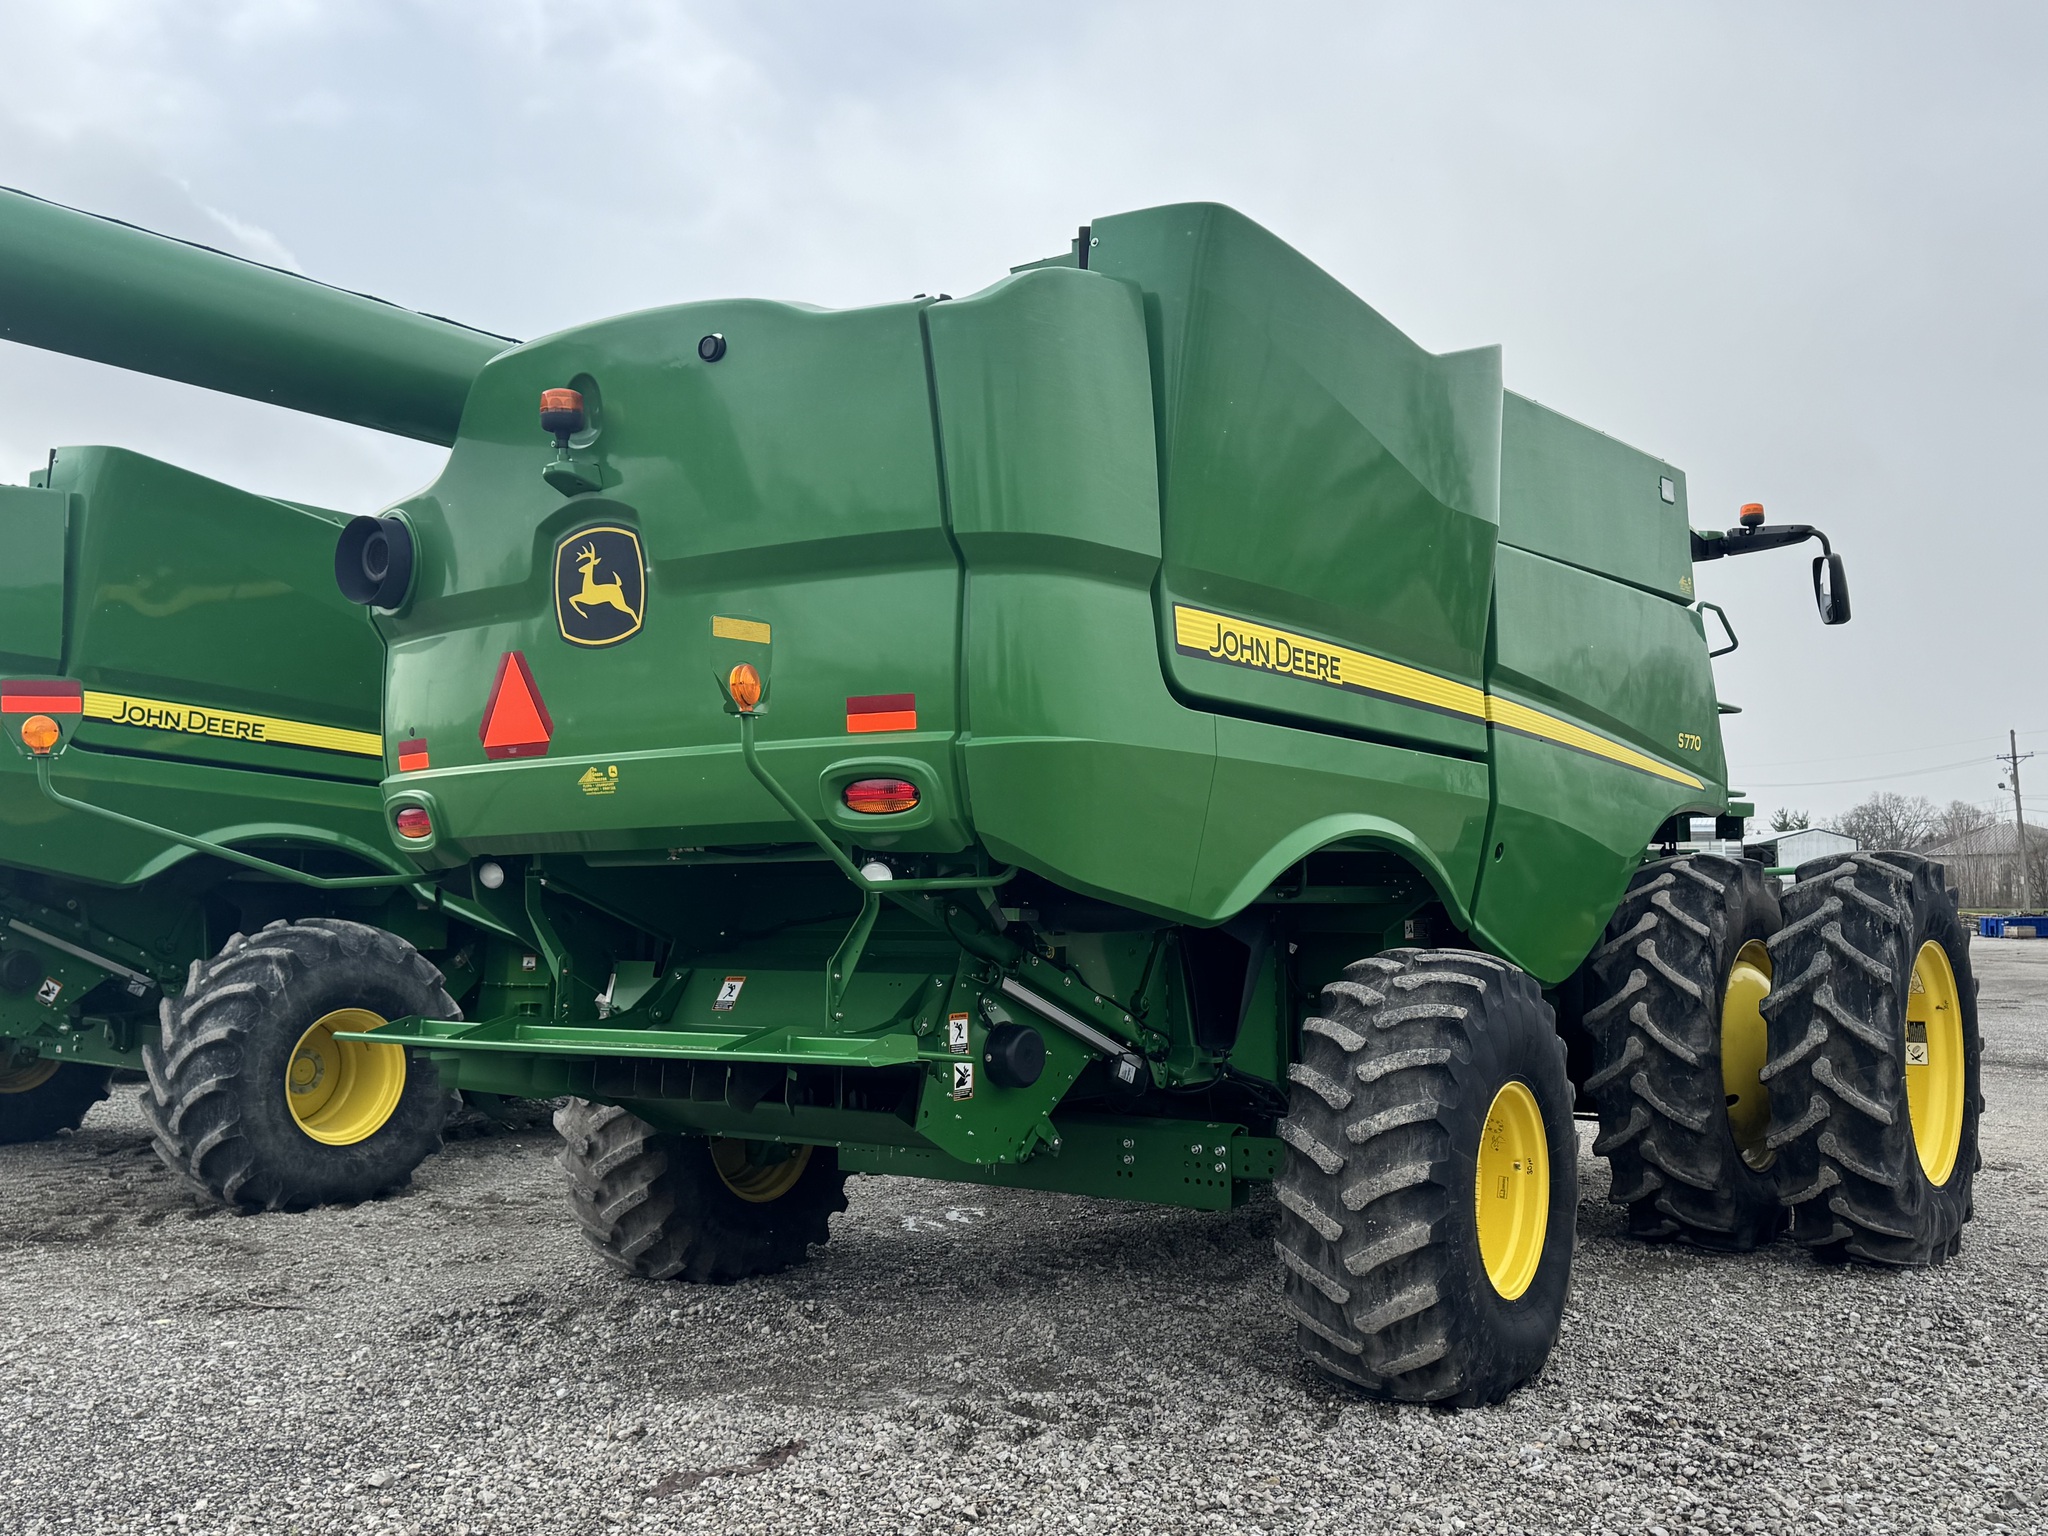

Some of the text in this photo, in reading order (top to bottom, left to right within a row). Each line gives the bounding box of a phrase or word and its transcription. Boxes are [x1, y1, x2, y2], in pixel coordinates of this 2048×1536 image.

[1209, 623, 1341, 681] JOHN DEERE
[112, 701, 265, 739] JOHN DEERE
[1678, 732, 1702, 752] S770
